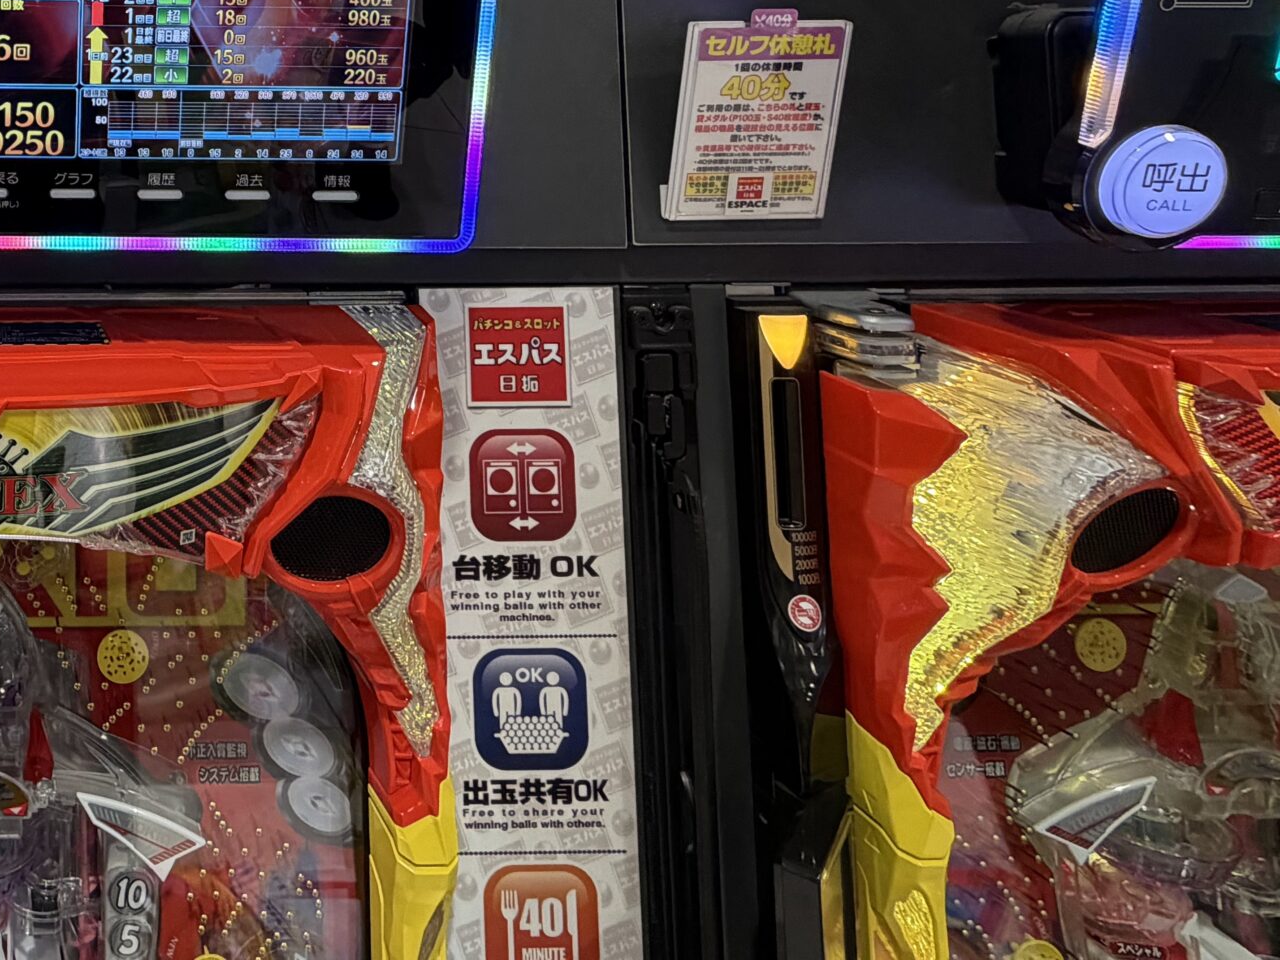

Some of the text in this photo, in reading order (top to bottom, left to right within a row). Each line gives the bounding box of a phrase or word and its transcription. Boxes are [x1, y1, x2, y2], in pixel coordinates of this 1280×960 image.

[125, 8, 391, 27] 1回目 超 18回 980玉
[223, 29, 246, 45] 0回
[706, 33, 836, 56] セルフ休憩札
[111, 47, 389, 66] 23回目 超 15回 960玉
[110, 67, 387, 85] 22回目 小 2回 220玉
[720, 72, 807, 101] 40分 です
[91, 98, 108, 107] 100
[53, 171, 93, 186] グラフ
[147, 172, 176, 187] 履歴
[236, 173, 263, 188] 過去
[323, 174, 351, 189] 情報
[1141, 161, 1211, 192] 呼出
[727, 199, 769, 209] ESPACE
[1145, 198, 1193, 212] CALL
[474, 336, 562, 365] エスパス
[452, 554, 600, 581] 台移動 OK
[451, 590, 601, 601] Free to play with your
[451, 601, 602, 612] winning balls with other
[499, 613, 556, 622] machines.
[515, 667, 545, 683] OK
[199, 767, 261, 783] システム搭載
[463, 778, 609, 806] 出玉共有OK
[462, 808, 605, 817] Free to share your
[464, 820, 606, 831] winning balls with others.
[116, 878, 147, 910] 10
[519, 897, 564, 938] 40
[117, 924, 141, 956] 5
[521, 947, 567, 960] MINUTE
[1117, 942, 1163, 959] スペシャル
